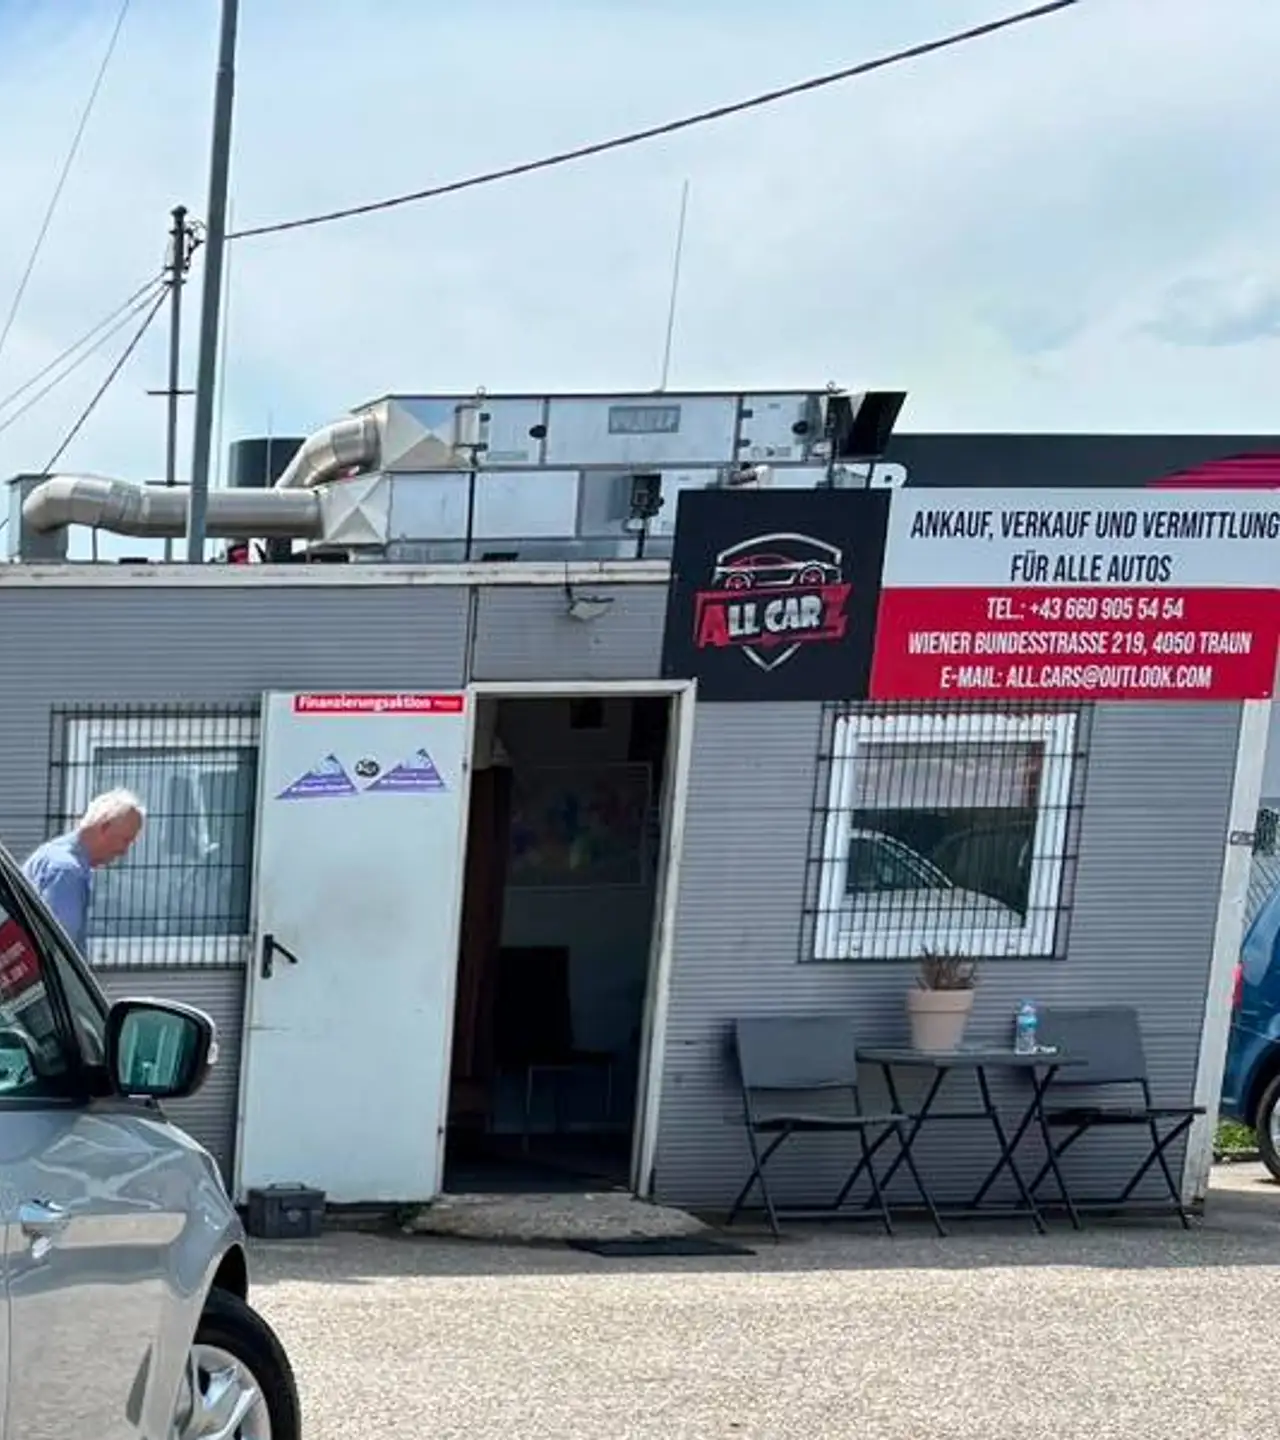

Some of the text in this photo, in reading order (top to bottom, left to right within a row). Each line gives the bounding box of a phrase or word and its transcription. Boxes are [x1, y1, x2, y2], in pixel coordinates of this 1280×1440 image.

[910, 510, 1280, 541] ANKAUF, VERKAUF UND VERMITTLUNG
[1010, 551, 1173, 583] FÜR ALLE AUTOS
[987, 597, 1185, 620] TEL.: +43 660 905 54 54
[698, 602, 761, 649] ALL
[908, 631, 1253, 656] WIENER BUNDESSTRASSE 219, 4050 TRAUN
[940, 666, 1213, 689] E-MAIL: ALL.CARS@OUTLOOK.COM
